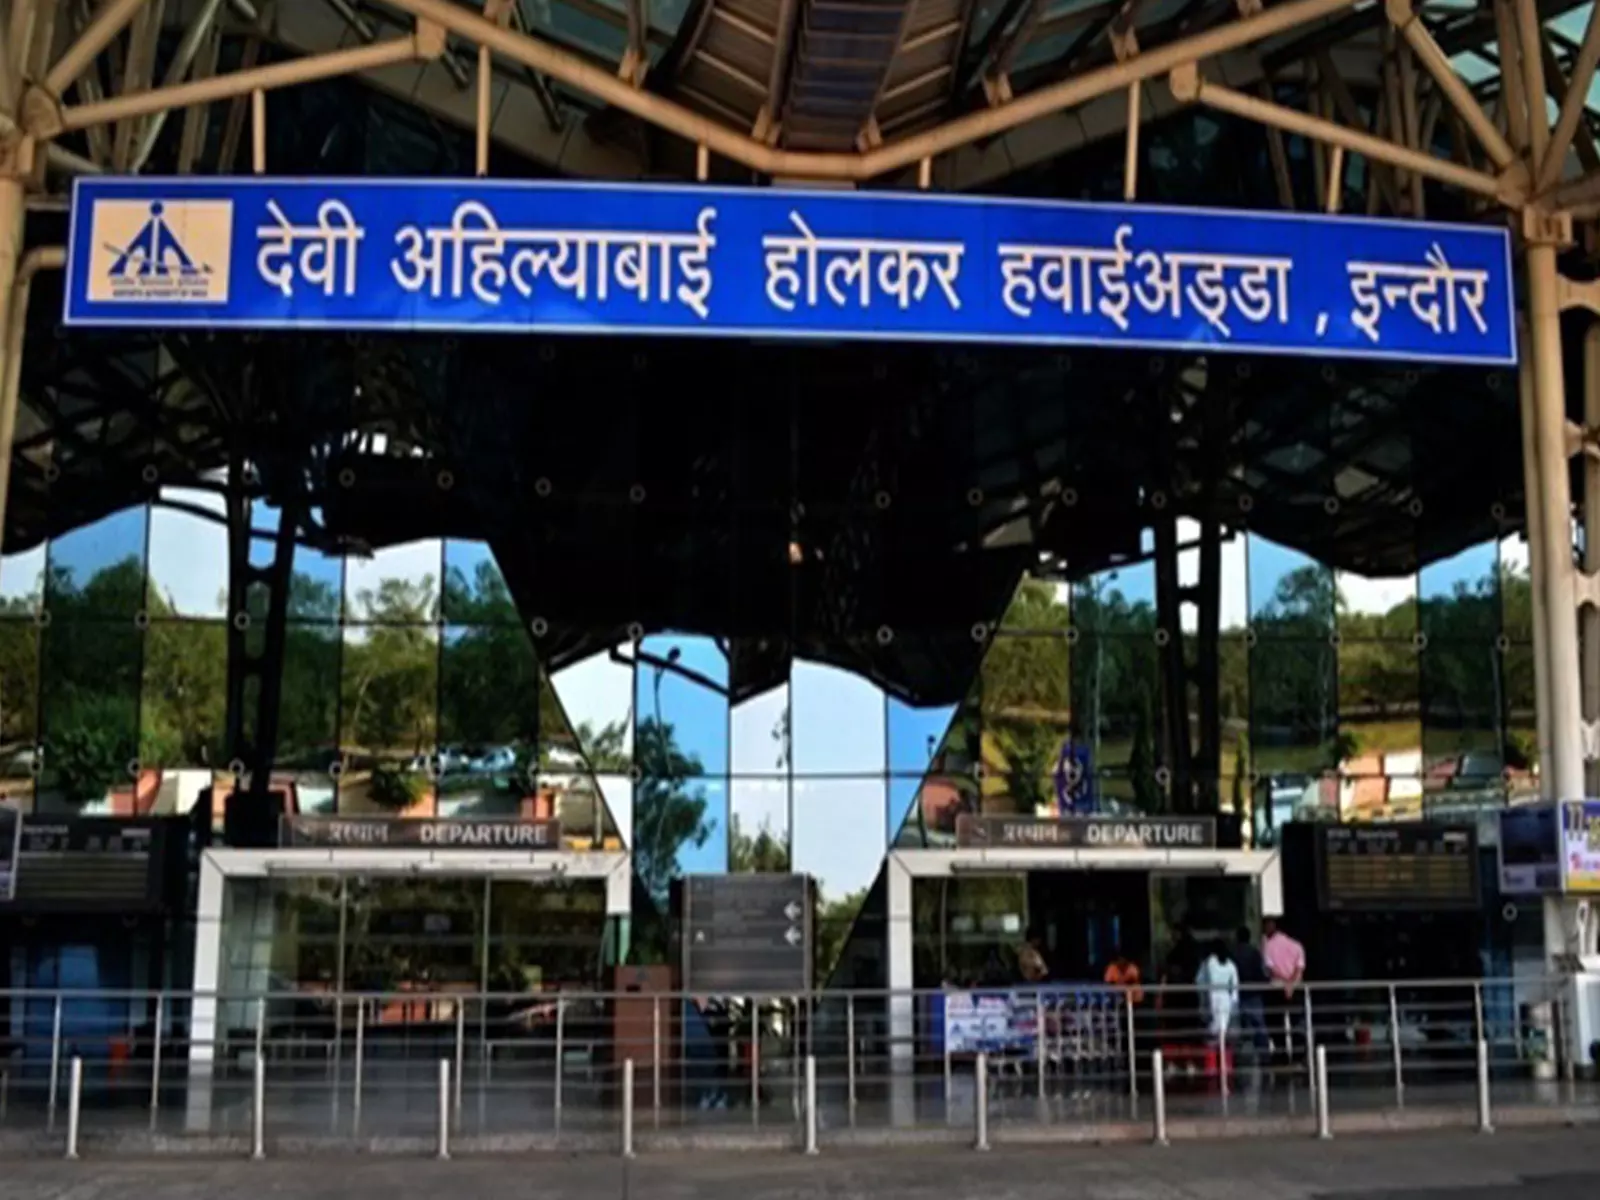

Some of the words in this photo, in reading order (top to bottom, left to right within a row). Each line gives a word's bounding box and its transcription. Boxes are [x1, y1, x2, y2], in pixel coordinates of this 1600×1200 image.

[256, 199, 365, 297] देवी
[390, 200, 717, 319] अहिल्याबाई
[762, 210, 964, 311] होलकर
[1346, 241, 1489, 343] इन्दौर
[420, 822, 548, 845] DEPARTURE
[1086, 822, 1204, 844] DEPARTURE
